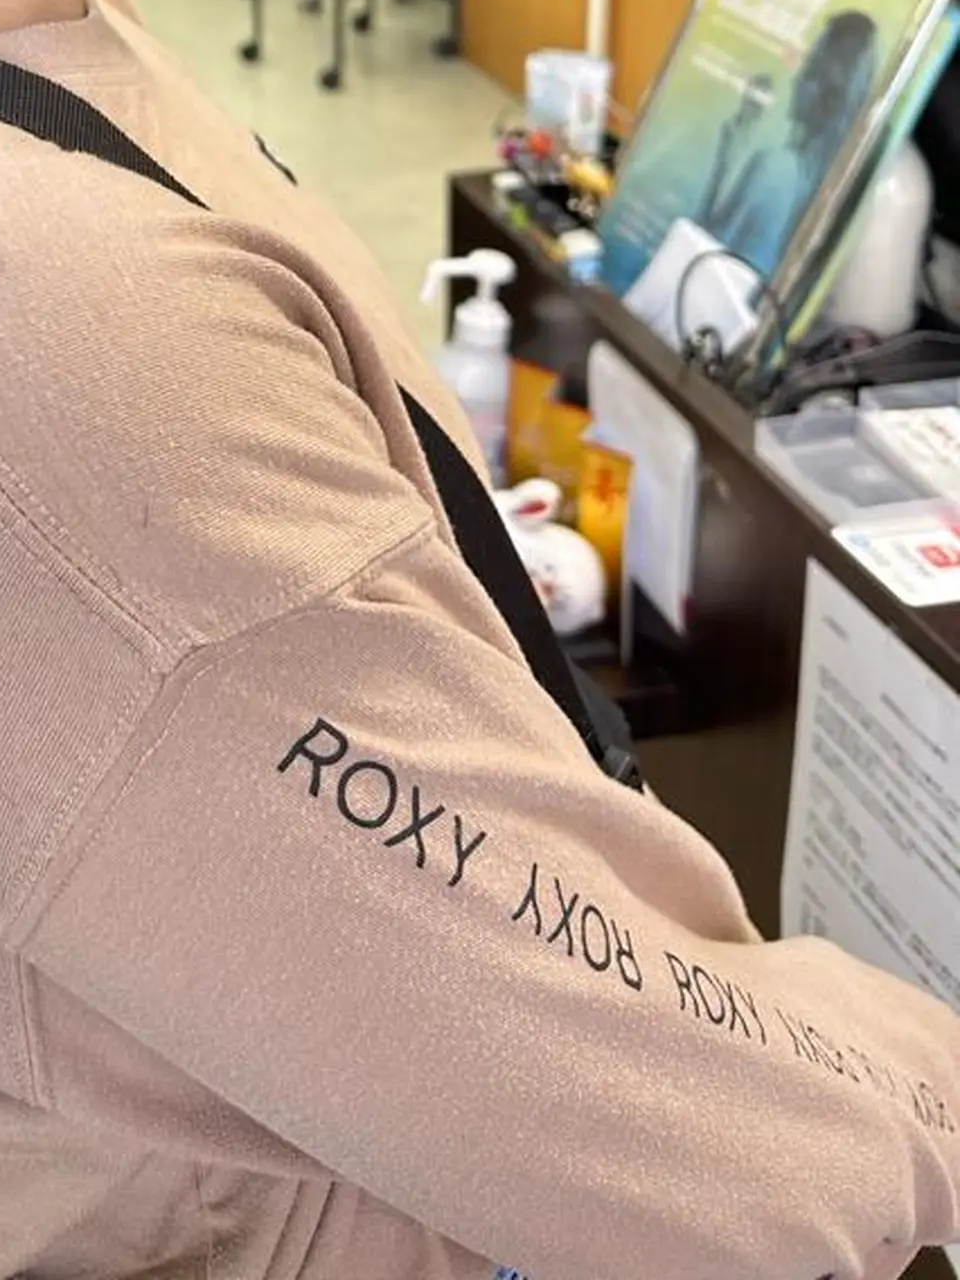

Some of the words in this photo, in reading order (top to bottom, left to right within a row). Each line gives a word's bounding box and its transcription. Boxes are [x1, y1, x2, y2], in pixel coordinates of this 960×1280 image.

[276, 717, 487, 887] ROXY
[511, 862, 643, 992] ROXY
[663, 950, 767, 1046] ROXY
